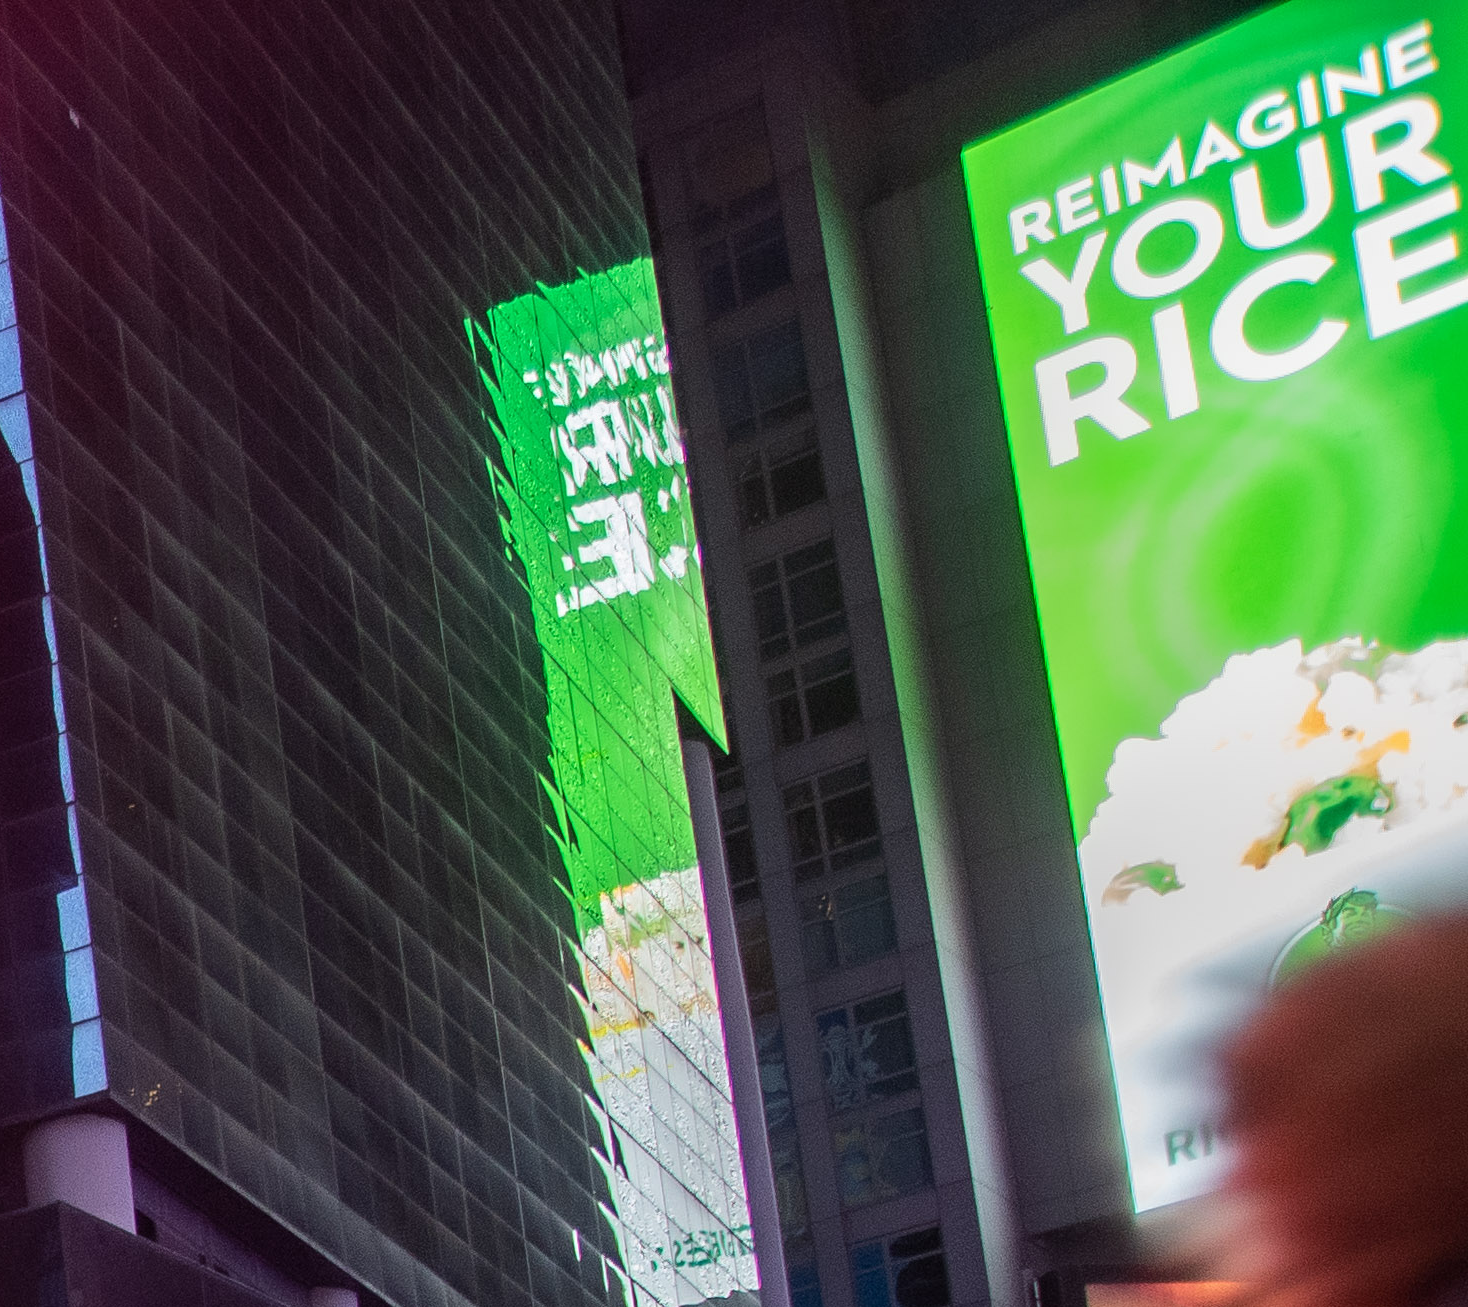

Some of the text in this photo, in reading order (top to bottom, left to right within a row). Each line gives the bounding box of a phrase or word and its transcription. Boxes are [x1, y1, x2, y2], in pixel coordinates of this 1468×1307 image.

[1010, 21, 1437, 257] REIMAGINE
[1022, 95, 1450, 335] YOUR
[1034, 191, 1468, 467] RICE
